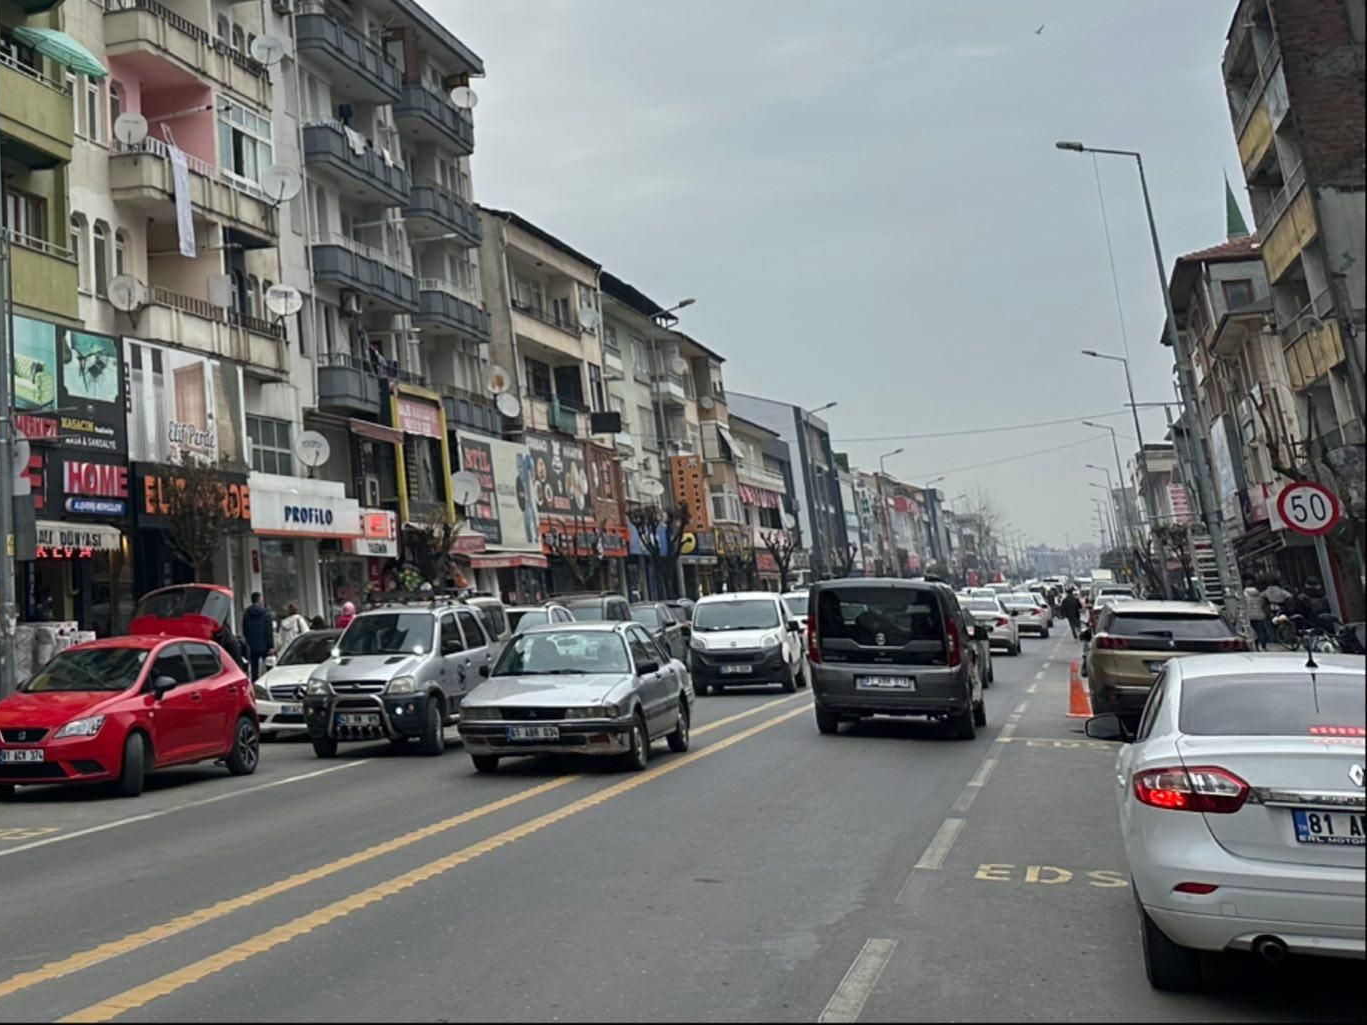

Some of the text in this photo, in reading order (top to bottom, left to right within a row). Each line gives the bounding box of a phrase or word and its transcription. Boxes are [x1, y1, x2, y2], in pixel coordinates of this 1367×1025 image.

[63, 460, 129, 498] HOME
[1290, 493, 1327, 523] 50
[1308, 813, 1333, 835] 81
[974, 863, 1130, 888] EDS
